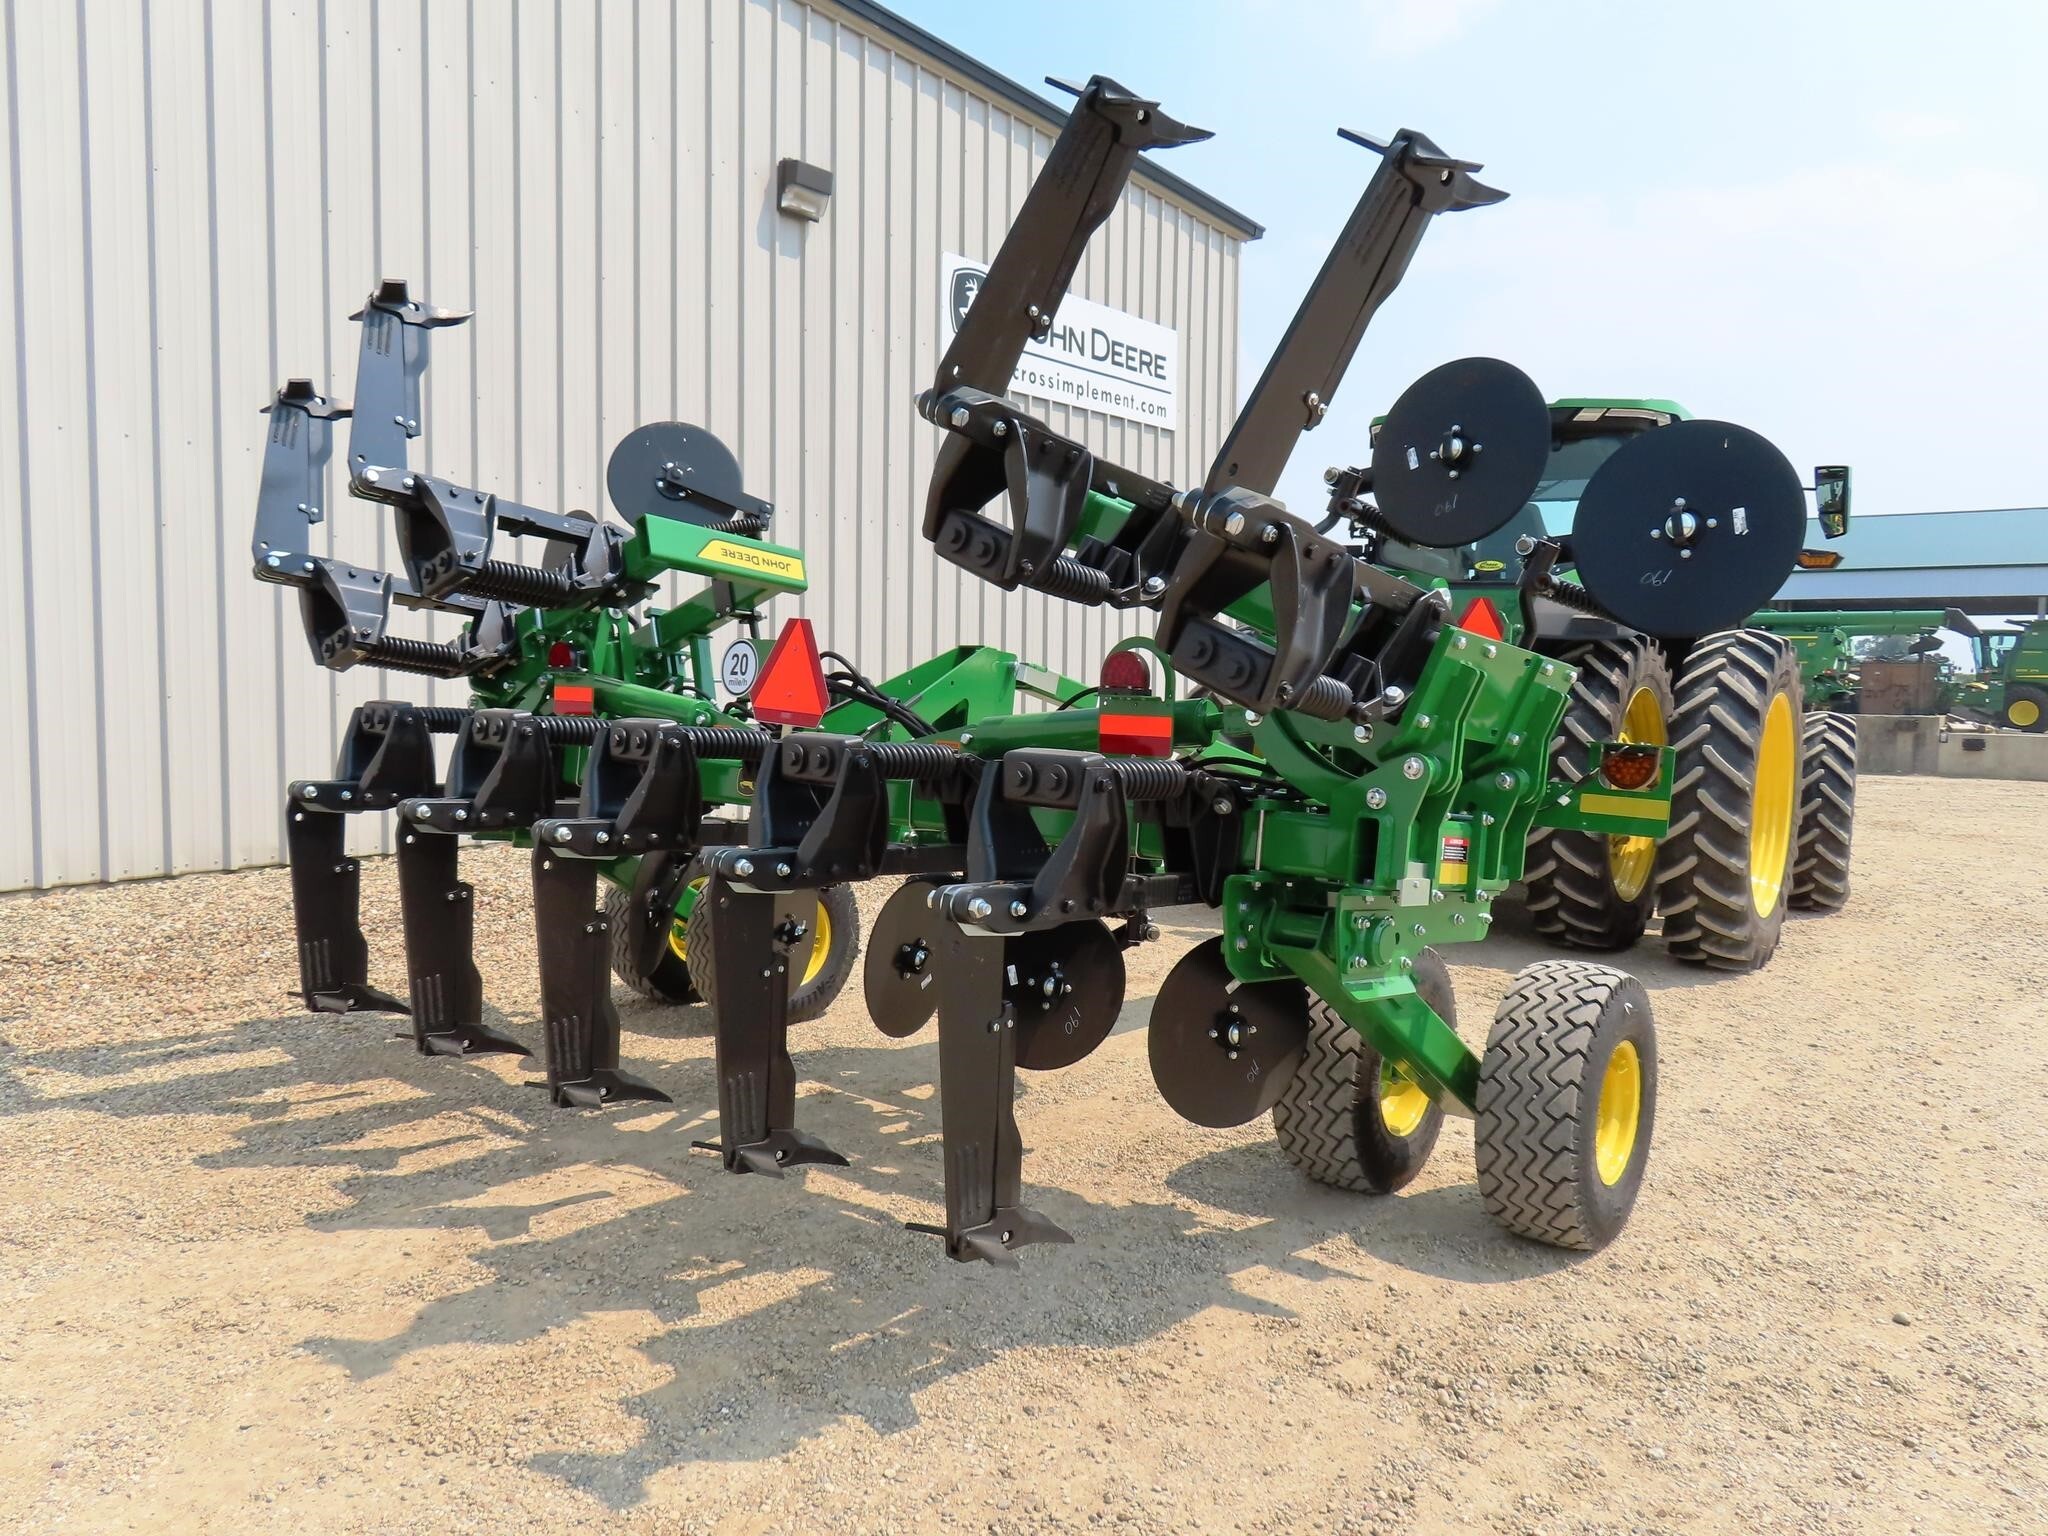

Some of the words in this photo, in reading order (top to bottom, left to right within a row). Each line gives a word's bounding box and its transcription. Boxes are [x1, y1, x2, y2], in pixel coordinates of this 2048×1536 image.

[1034, 321, 1085, 357] HN
[1091, 327, 1167, 381] DEERE
[1013, 367, 1167, 418] crossimplement.com
[720, 548, 760, 566] DEERE
[762, 557, 791, 572] JOHN
[730, 653, 749, 676] 20
